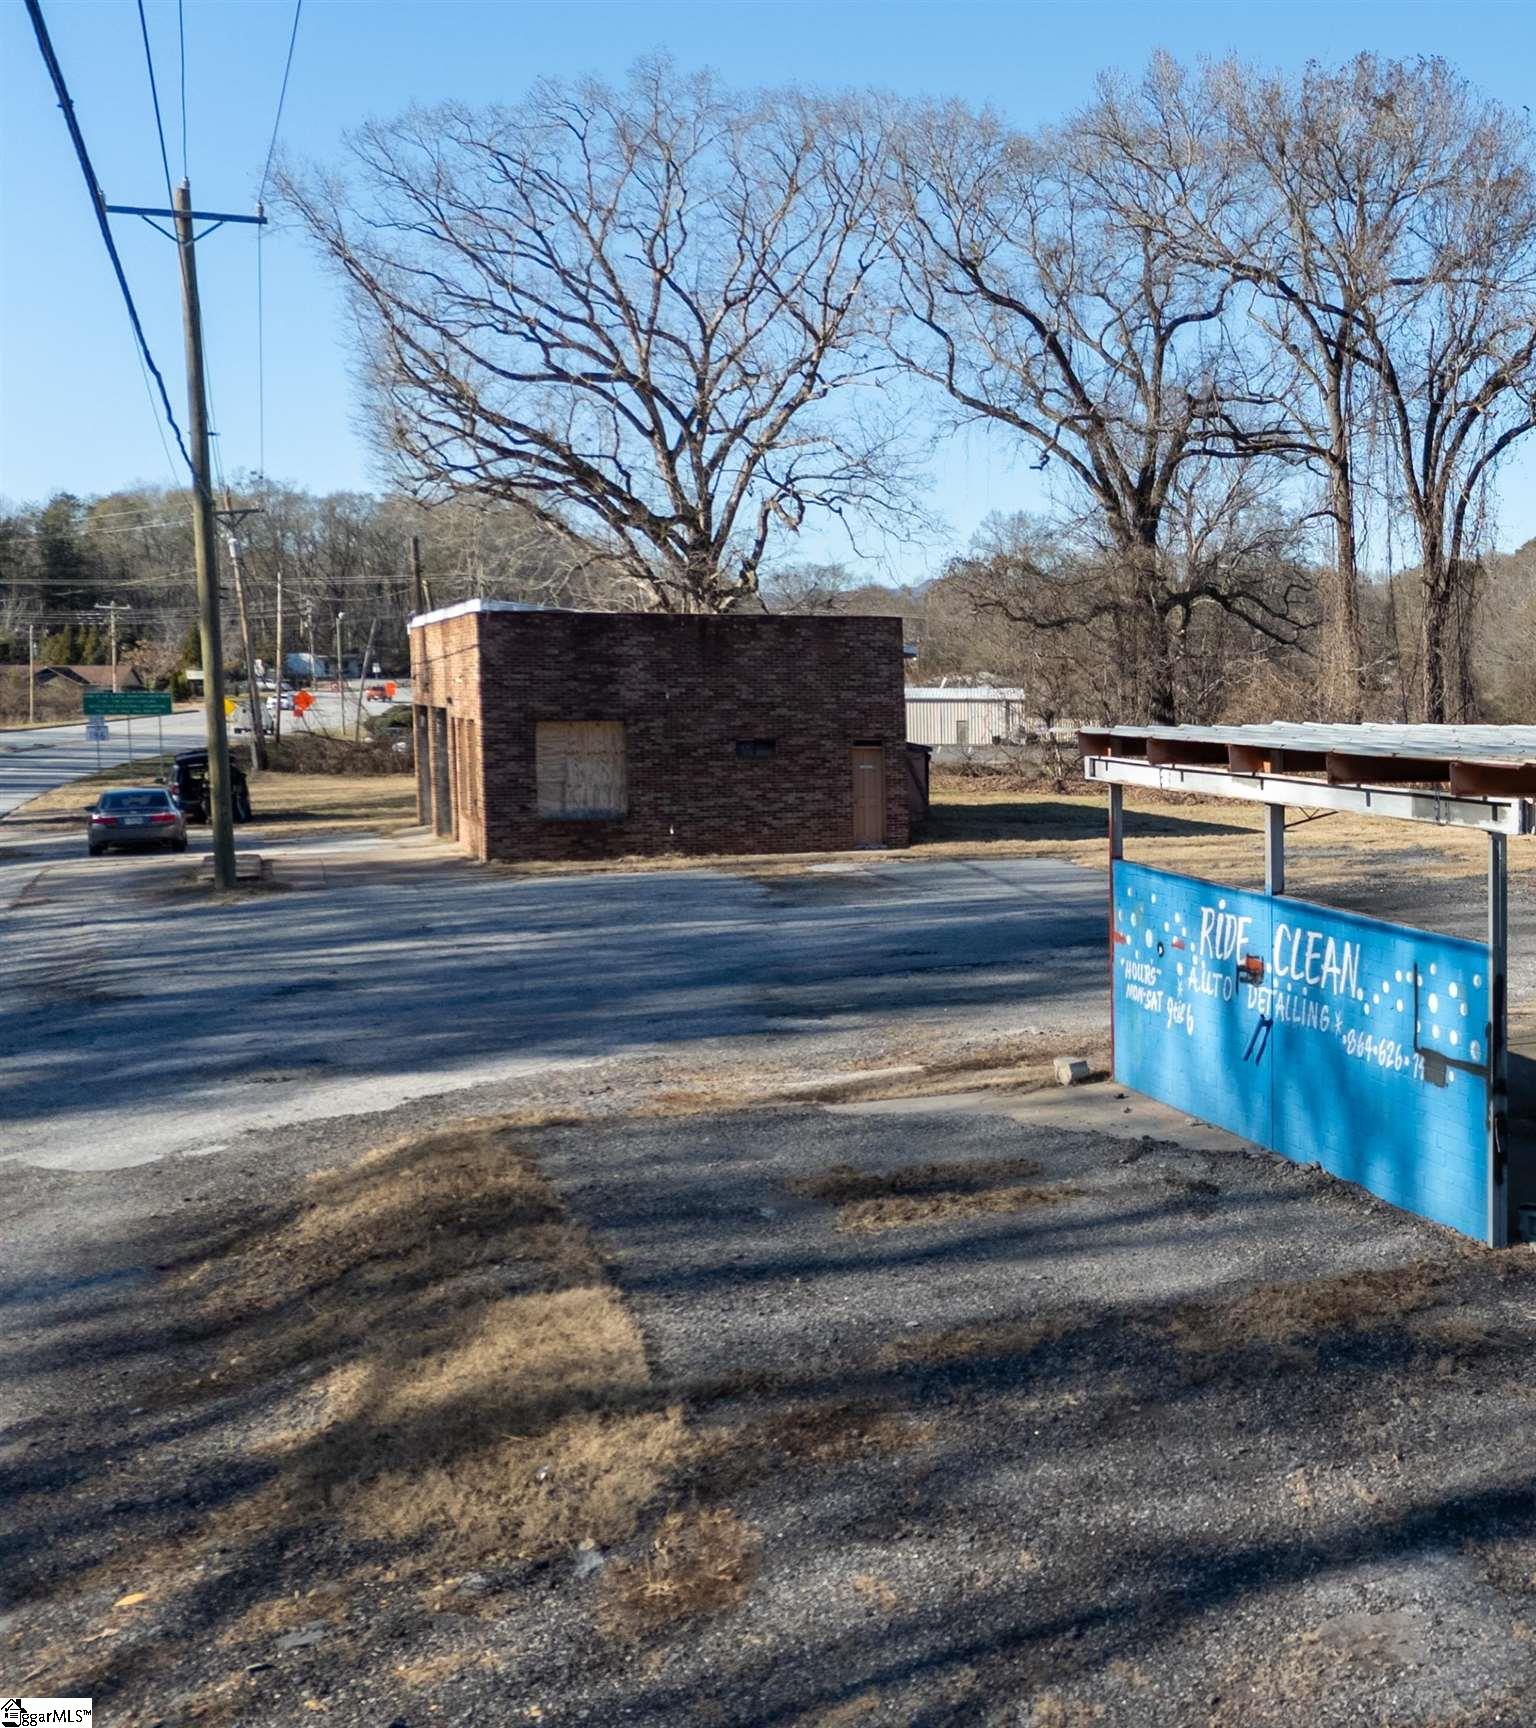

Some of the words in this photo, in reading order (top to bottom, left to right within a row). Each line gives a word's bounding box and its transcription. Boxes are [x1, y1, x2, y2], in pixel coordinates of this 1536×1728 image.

[1200, 905, 1252, 966] RIDE
[1273, 923, 1361, 998] CLEAN
[1188, 962, 1232, 1002] AUTO
[1247, 984, 1330, 1033] DETAILING
